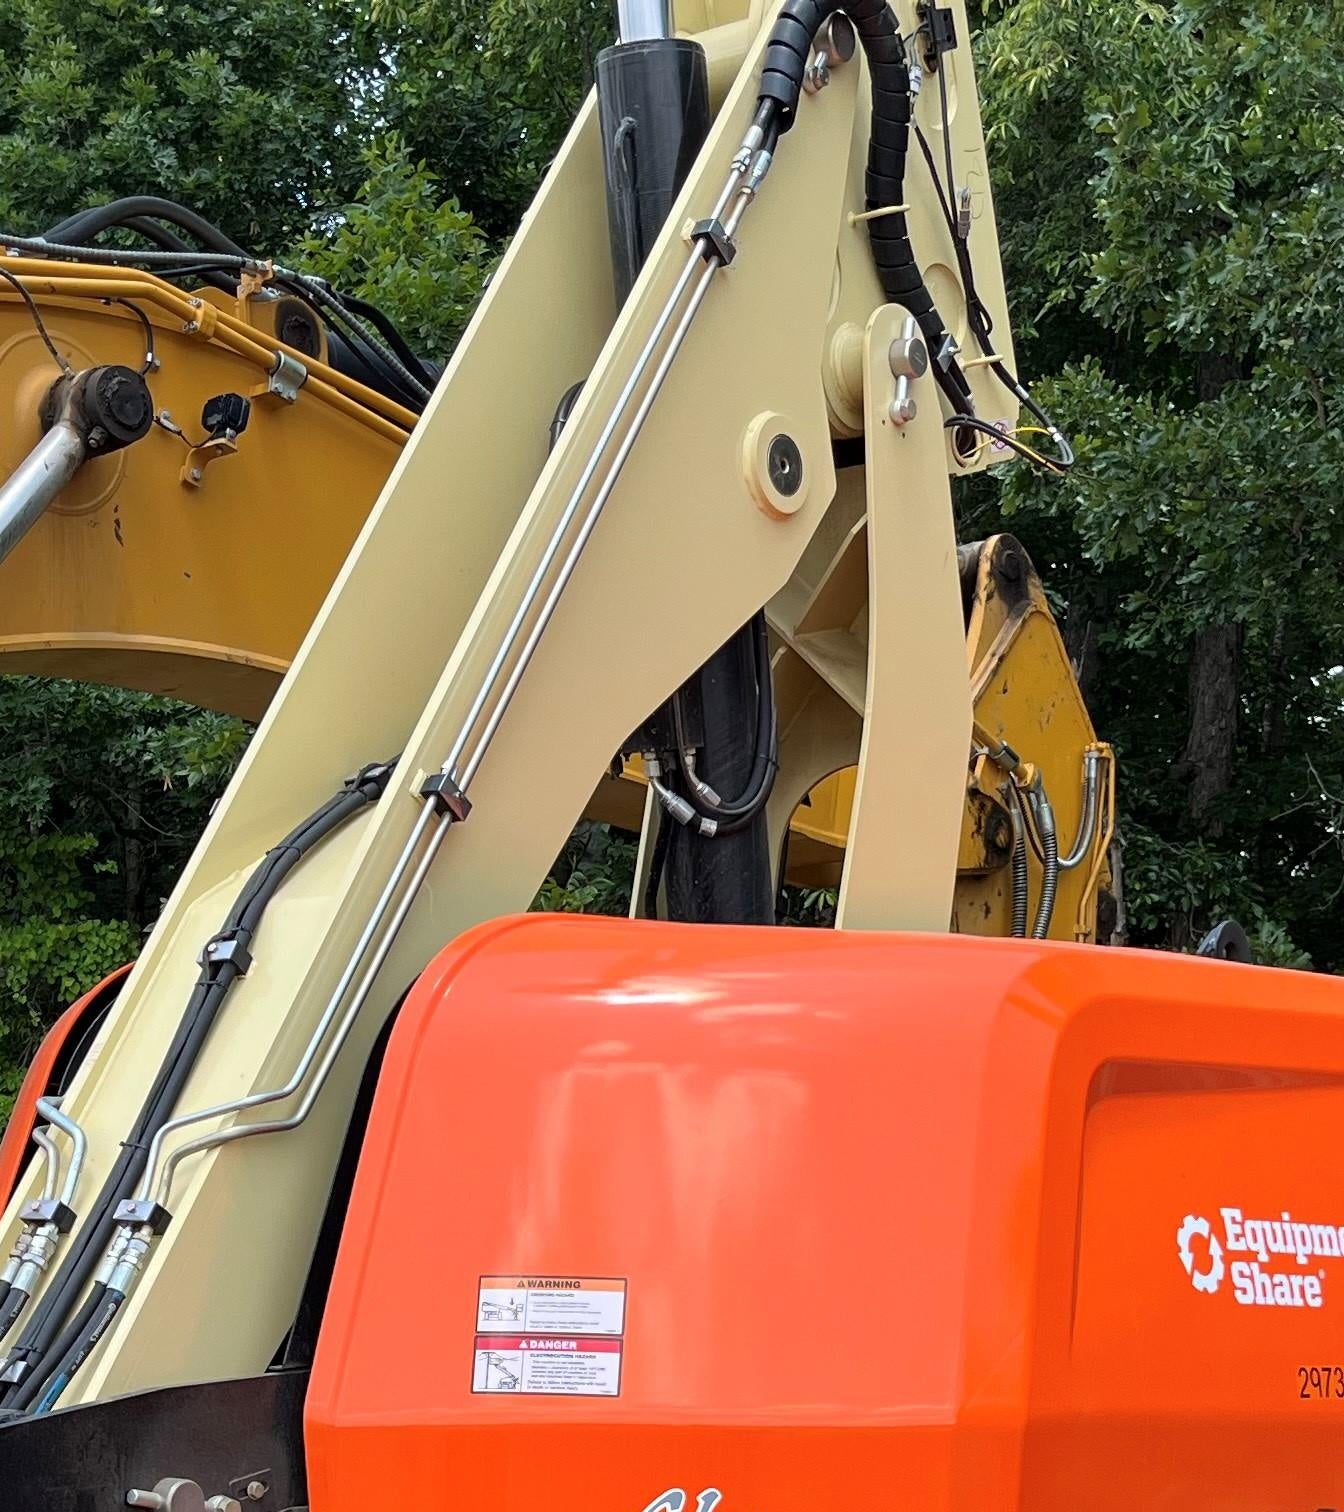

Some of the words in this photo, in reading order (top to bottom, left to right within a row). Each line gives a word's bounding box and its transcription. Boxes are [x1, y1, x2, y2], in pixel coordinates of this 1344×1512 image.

[527, 1280, 581, 1289] WARNING
[1231, 1261, 1323, 1308] Share
[529, 1340, 577, 1350] DANGER
